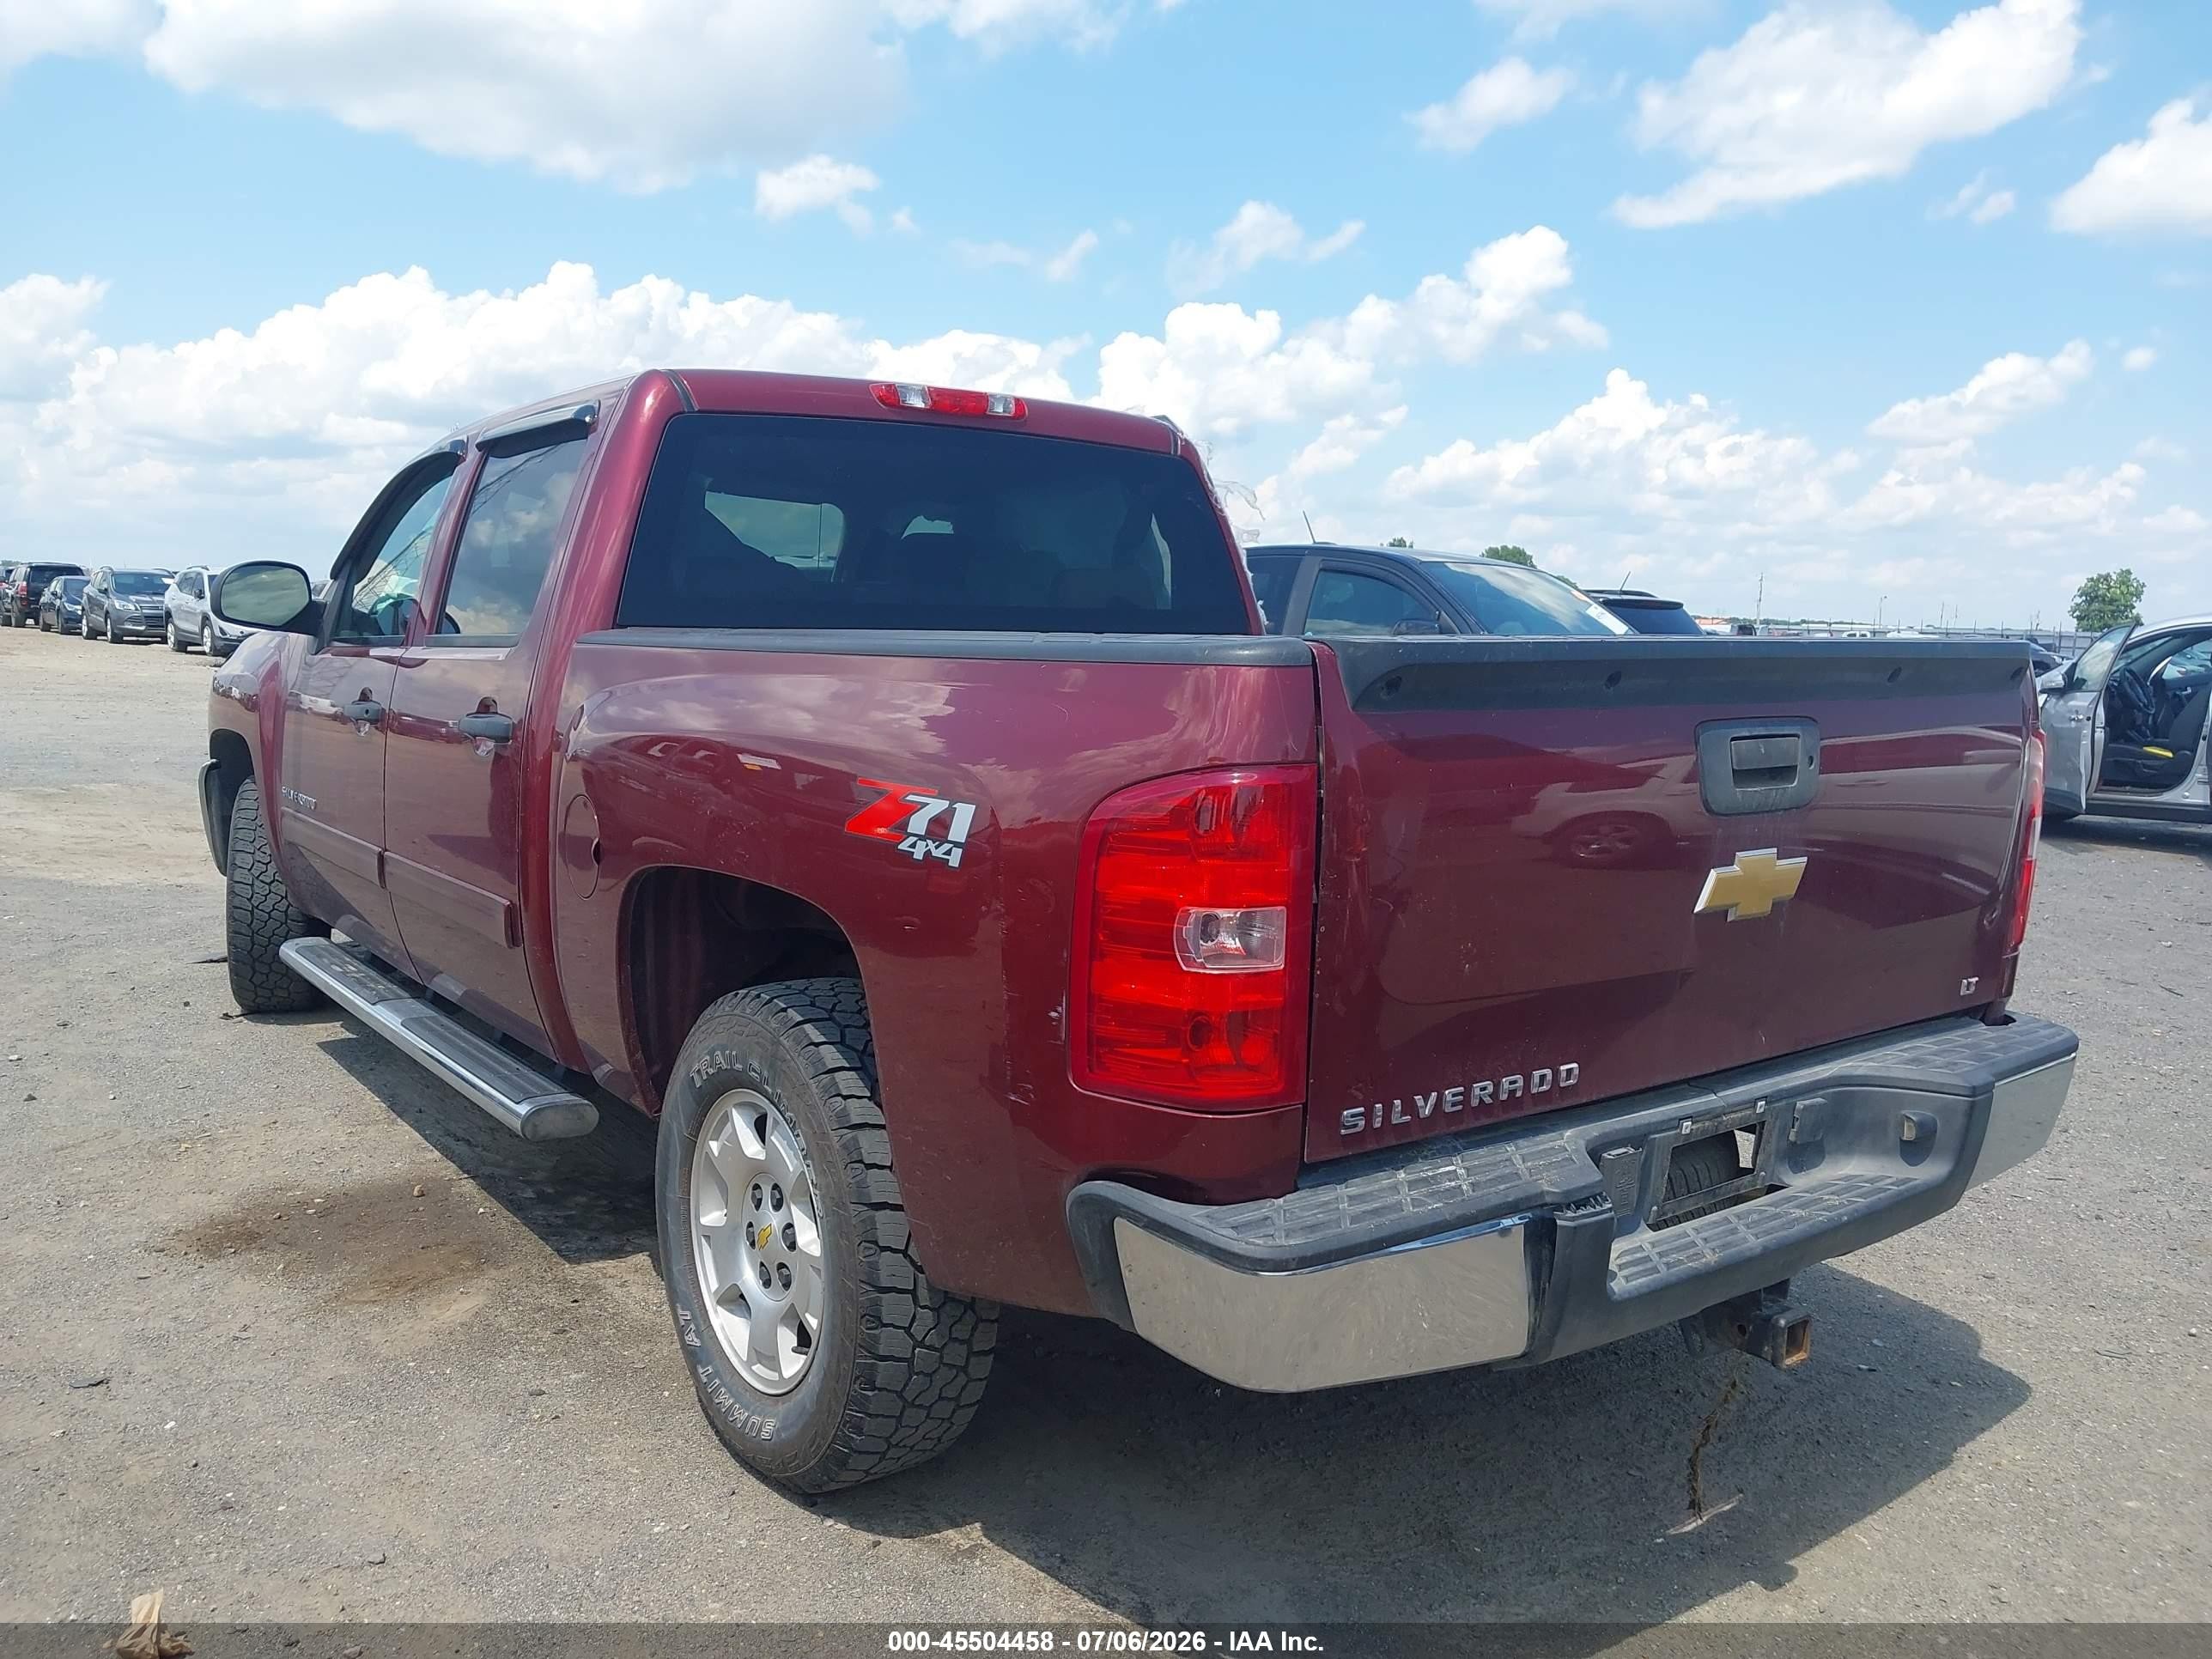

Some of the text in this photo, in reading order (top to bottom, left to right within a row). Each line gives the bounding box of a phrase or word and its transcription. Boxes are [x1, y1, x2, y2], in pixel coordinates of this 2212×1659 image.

[844, 776, 977, 843] Z71
[1960, 976, 1979, 996] LT
[690, 1050, 743, 1089] TRAIL
[1340, 1061, 1580, 1135] SILVERADO
[696, 1364, 777, 1442] SUMMIT
